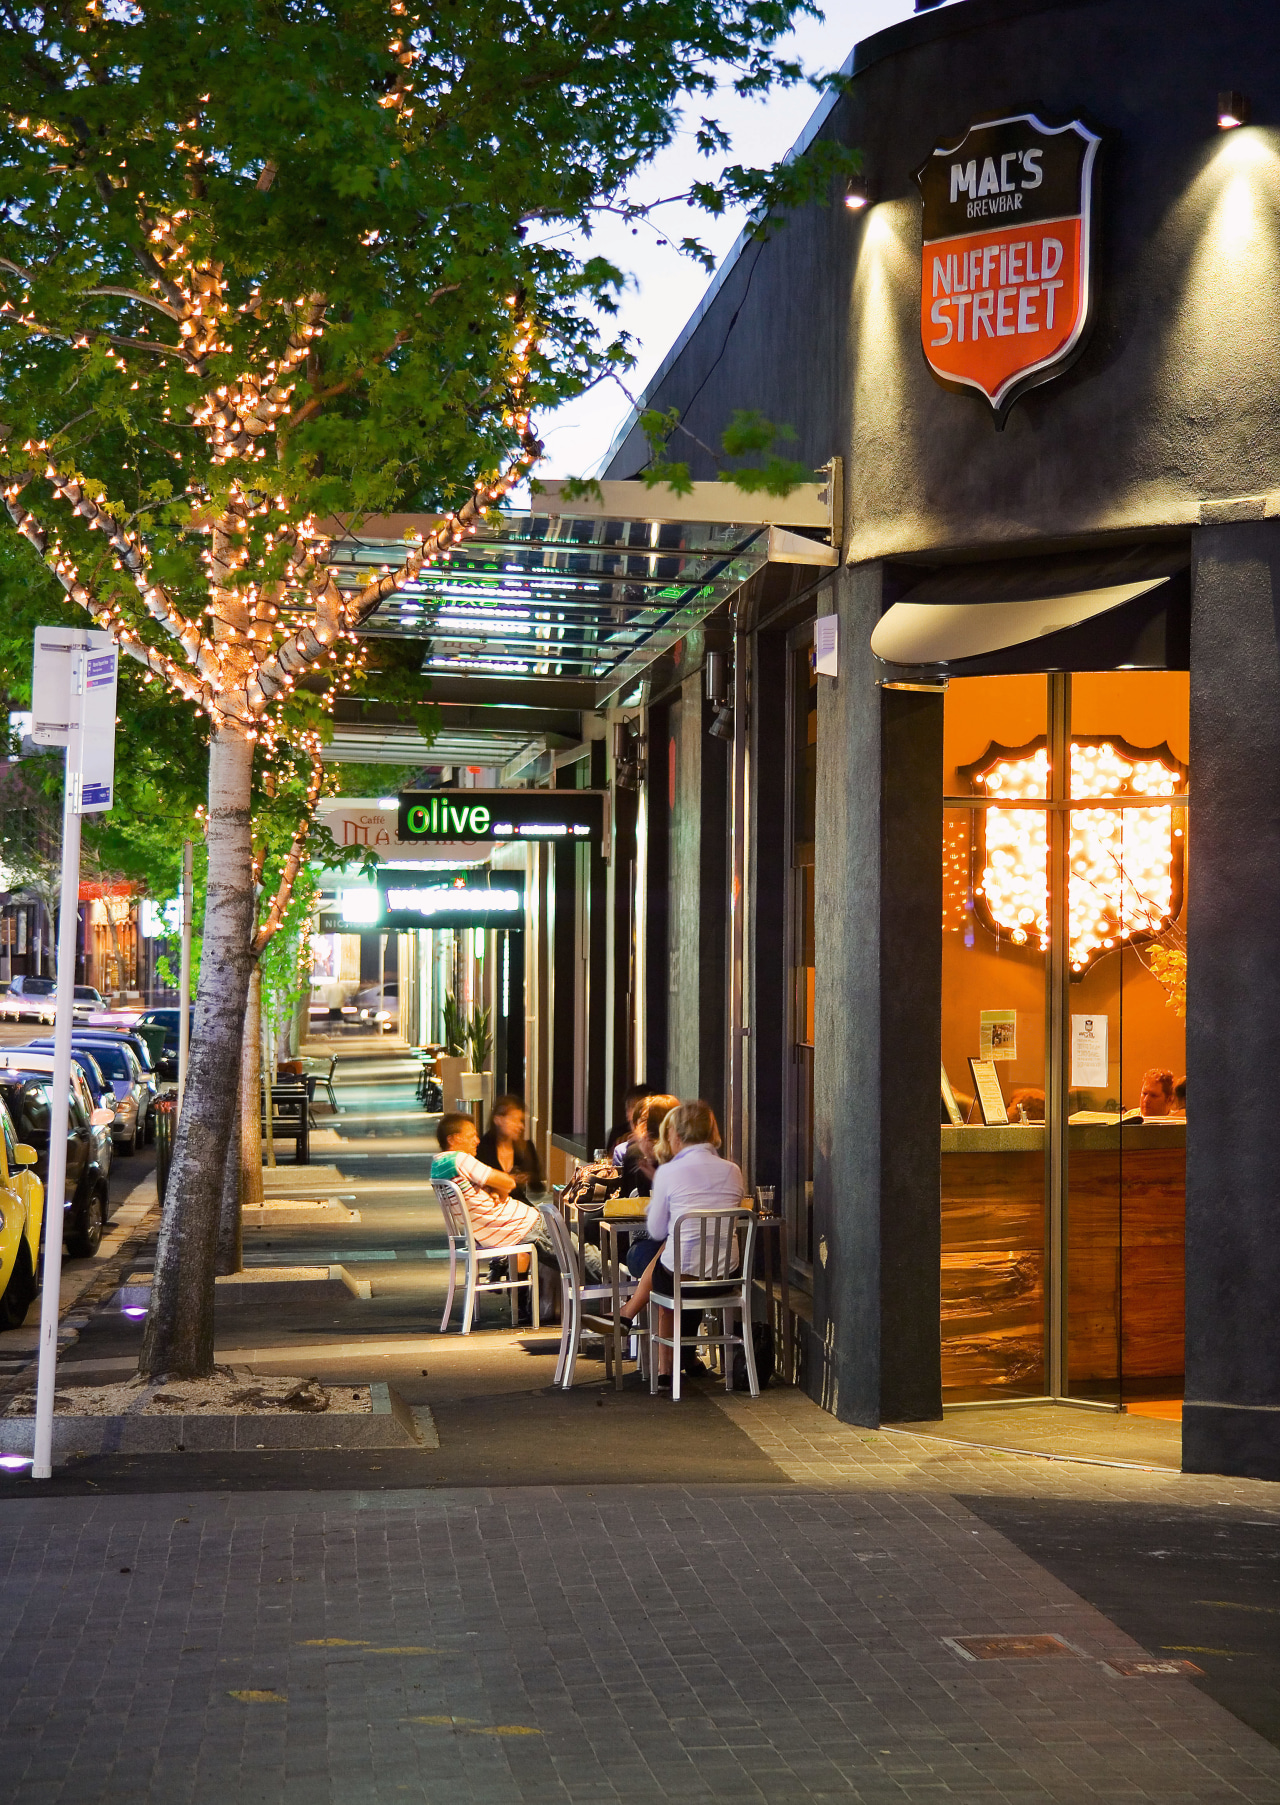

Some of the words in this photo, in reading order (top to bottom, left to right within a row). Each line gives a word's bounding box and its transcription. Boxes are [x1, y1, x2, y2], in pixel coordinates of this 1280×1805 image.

[950, 148, 1044, 203] MAC'S
[966, 192, 1023, 219] BREWBAR
[930, 280, 1064, 347] STREET
[360, 815, 386, 825] Caffé
[407, 797, 491, 834] olive
